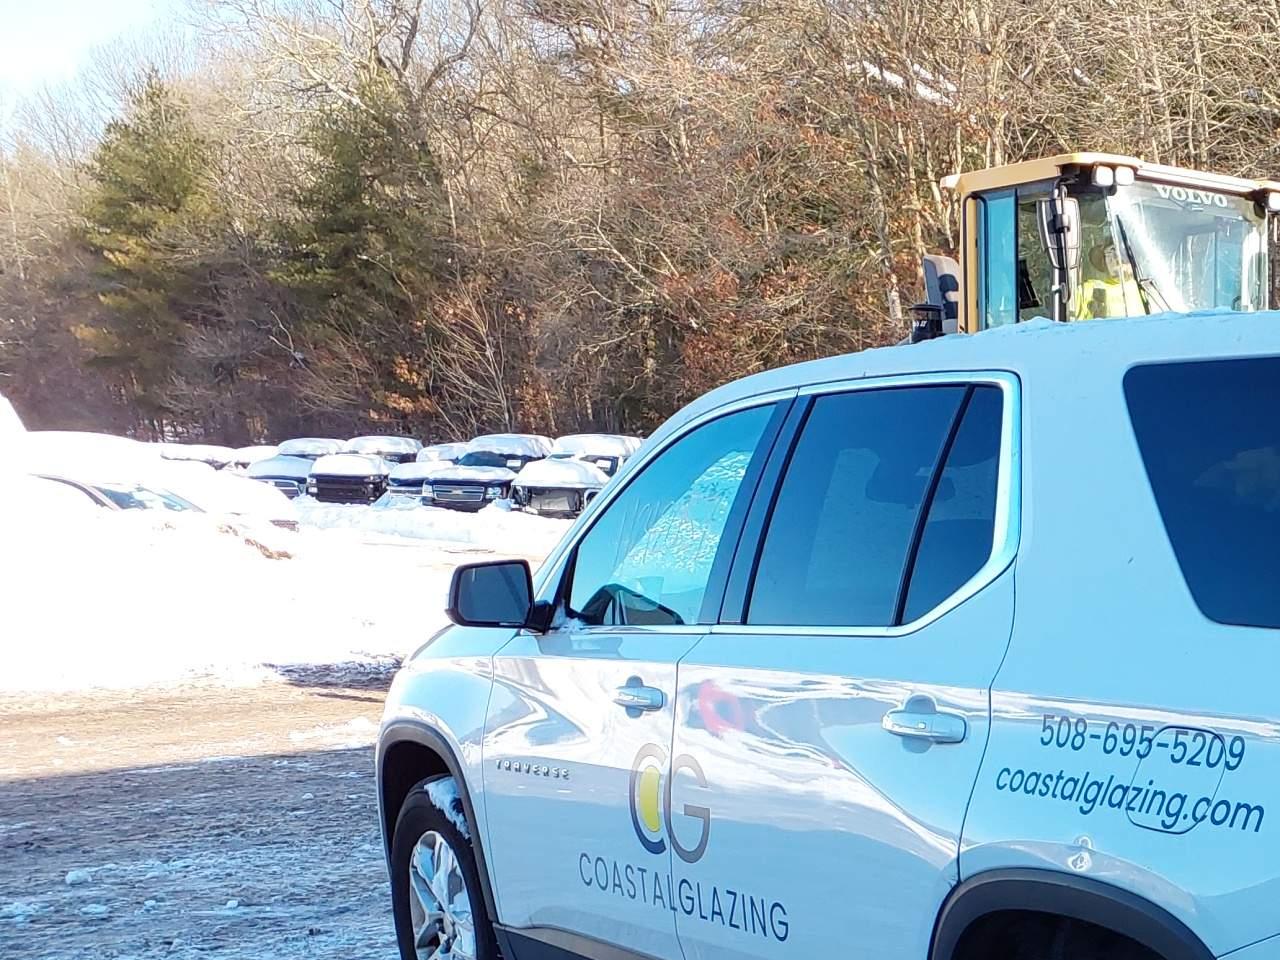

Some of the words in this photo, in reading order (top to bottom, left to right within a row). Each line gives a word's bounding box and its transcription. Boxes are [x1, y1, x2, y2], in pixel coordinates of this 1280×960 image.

[1152, 184, 1228, 208] VOLVO
[1040, 714, 1246, 772] 508-695-5209
[495, 759, 571, 781] TRAVERSE
[995, 767, 1265, 833] coastalglazing.com
